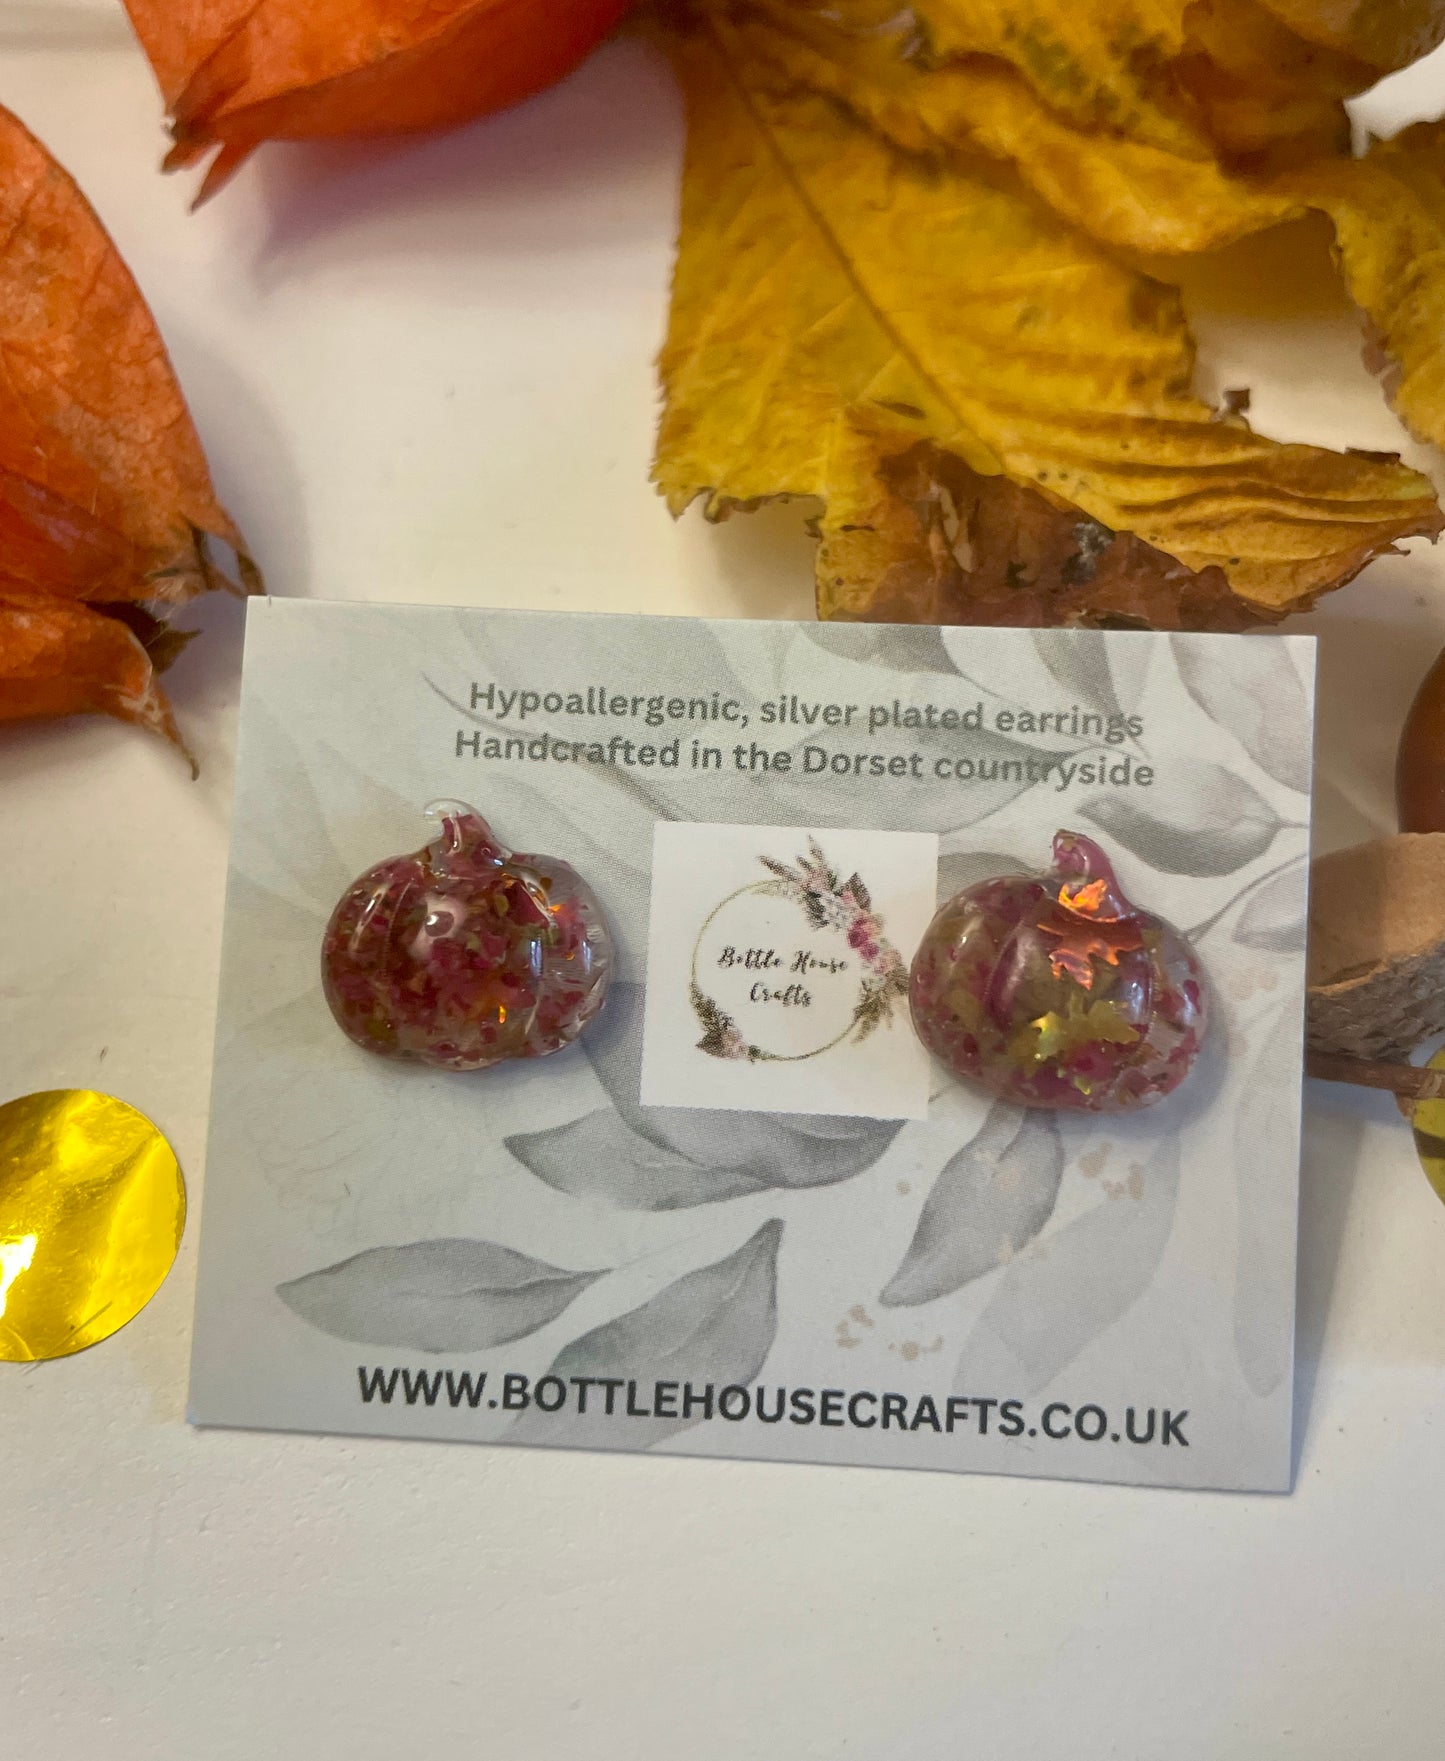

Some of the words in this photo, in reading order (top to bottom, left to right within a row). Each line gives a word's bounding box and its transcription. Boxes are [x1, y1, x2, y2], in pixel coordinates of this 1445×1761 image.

[470, 682, 748, 729] Hypoallergenic,
[759, 696, 858, 727] silver
[867, 699, 984, 735] plated
[994, 705, 1144, 744] earrings
[454, 730, 680, 768] Handcrafted
[691, 738, 723, 769] in
[732, 741, 792, 773] the
[802, 745, 924, 780] Dorset
[933, 754, 1155, 792] countryside
[717, 945, 783, 969] Bottle
[789, 949, 848, 975] House
[749, 981, 812, 1008] Crafts
[356, 1364, 1191, 1447] WWW.BOTTLEHOUSECRAFTS.CO.UK
